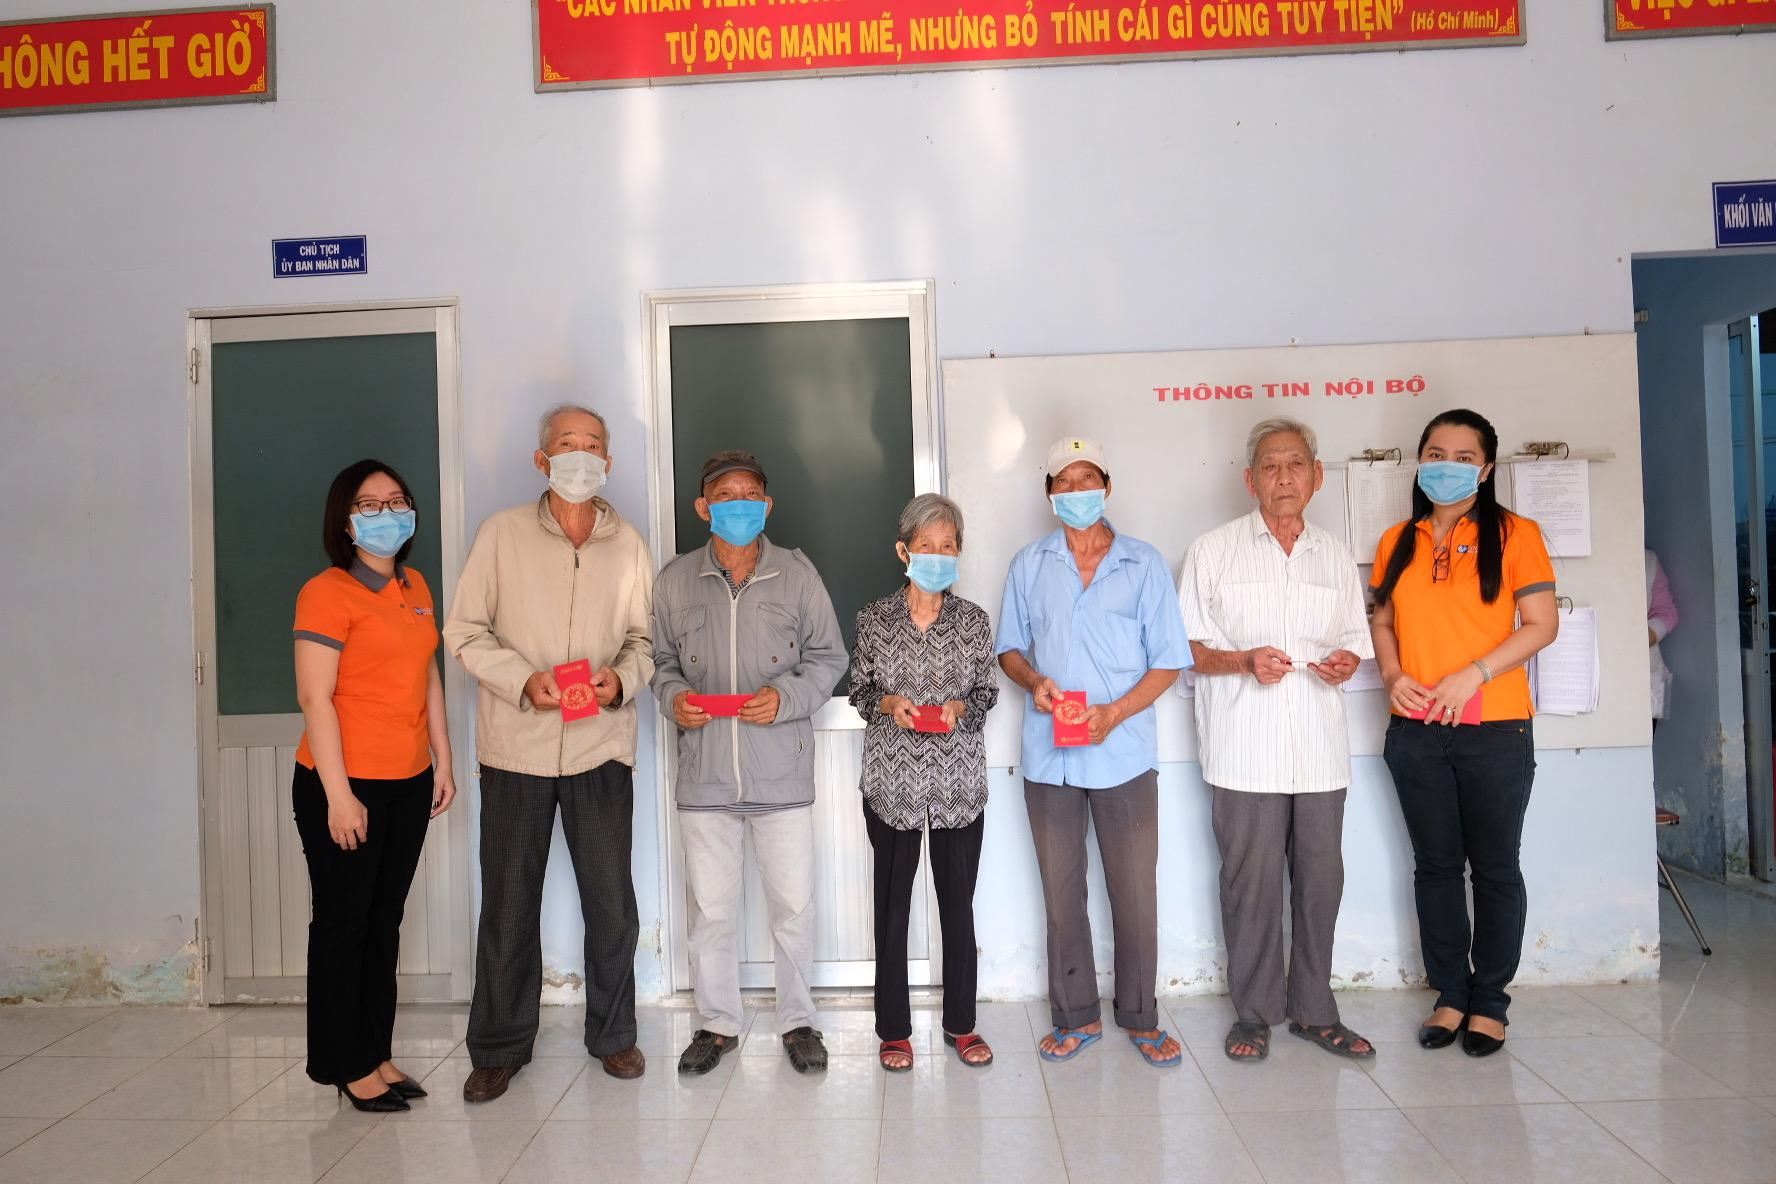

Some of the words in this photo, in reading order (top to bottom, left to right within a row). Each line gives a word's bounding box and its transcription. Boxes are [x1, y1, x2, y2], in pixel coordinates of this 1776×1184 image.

[103, 19, 175, 83] HẾT
[186, 19, 252, 79] GIỜ
[665, 23, 698, 72] TỰ
[703, 19, 773, 70] ĐỘNG
[780, 21, 852, 65] MẠNH
[859, 11, 902, 61] MẼ,
[909, 8, 998, 52] NHƯNG
[1004, 0, 1038, 47] BỎ
[1050, 2, 1110, 44] TÍNH
[1117, 0, 1160, 42] CÁI
[1167, 0, 1193, 39] GÌ
[1438, 10, 1460, 30] Chí
[1463, 8, 1499, 30] Minh)
[1723, 193, 1750, 228] KHỐI
[1751, 197, 1773, 227] VĂN
[281, 258, 293, 272] ỦY
[295, 260, 313, 271] BAN
[315, 257, 339, 271] NHÂN
[341, 256, 360, 269] DÂN
[299, 242, 317, 256] CHỦ
[320, 244, 340, 257] TỊCH
[1153, 382, 1253, 402] THÔNG
[1261, 382, 1310, 398] TIN
[1324, 377, 1374, 398] NỘI
[1385, 375, 1426, 396] BỘ
